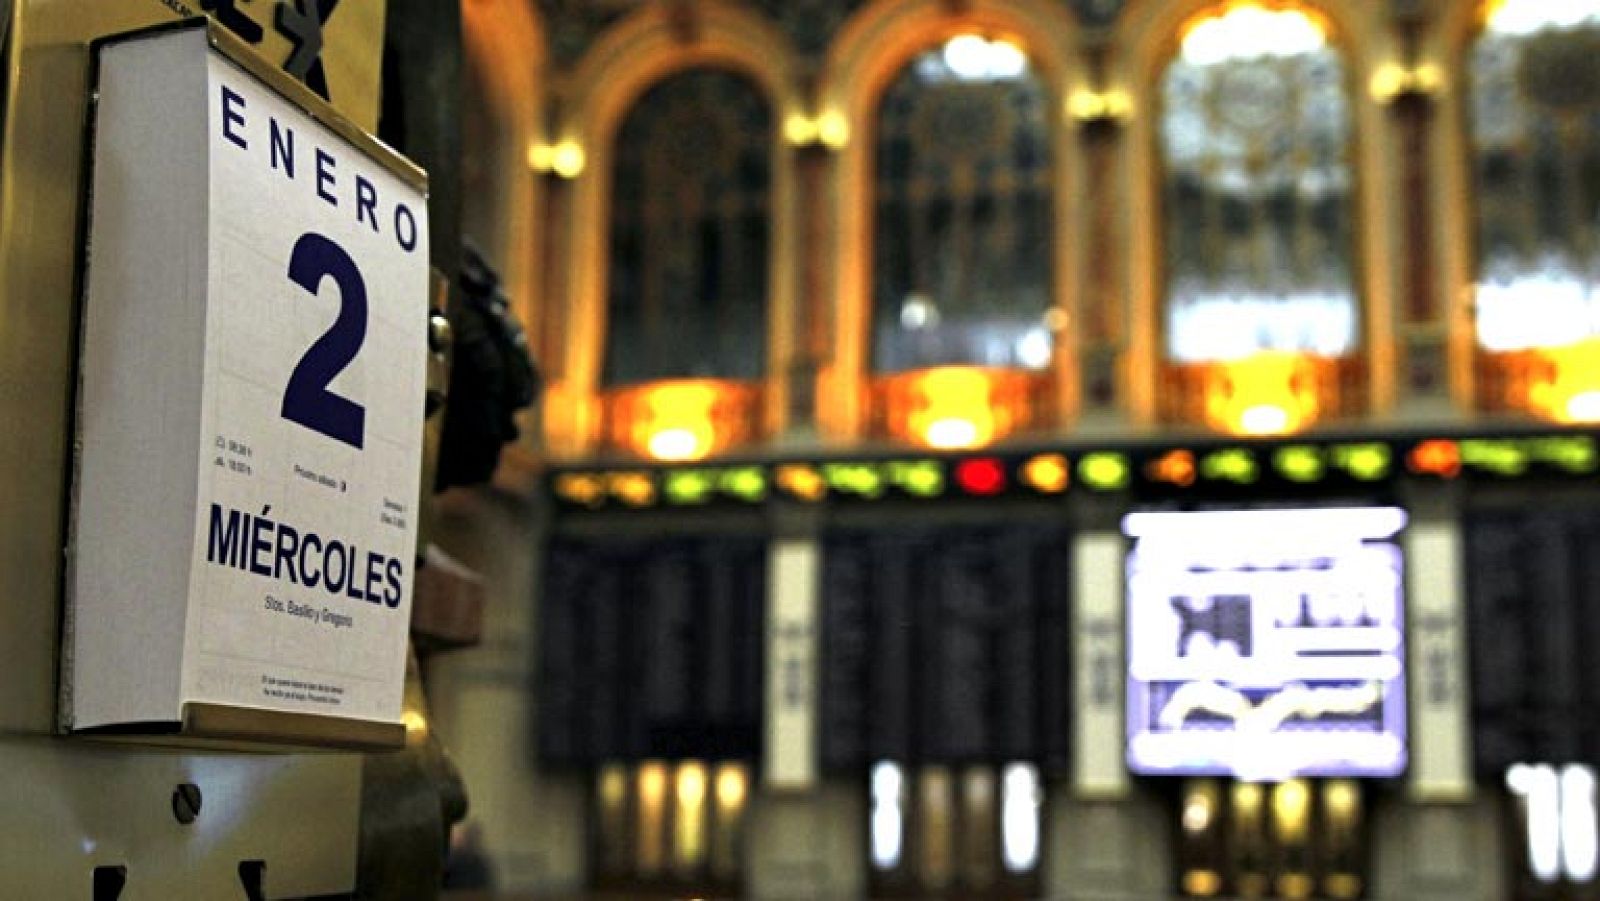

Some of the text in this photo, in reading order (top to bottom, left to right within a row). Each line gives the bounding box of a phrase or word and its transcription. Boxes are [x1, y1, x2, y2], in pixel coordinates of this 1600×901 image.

[220, 84, 418, 253] ENERO
[280, 231, 368, 451] 2
[207, 502, 403, 609] MIÉRCOLES
